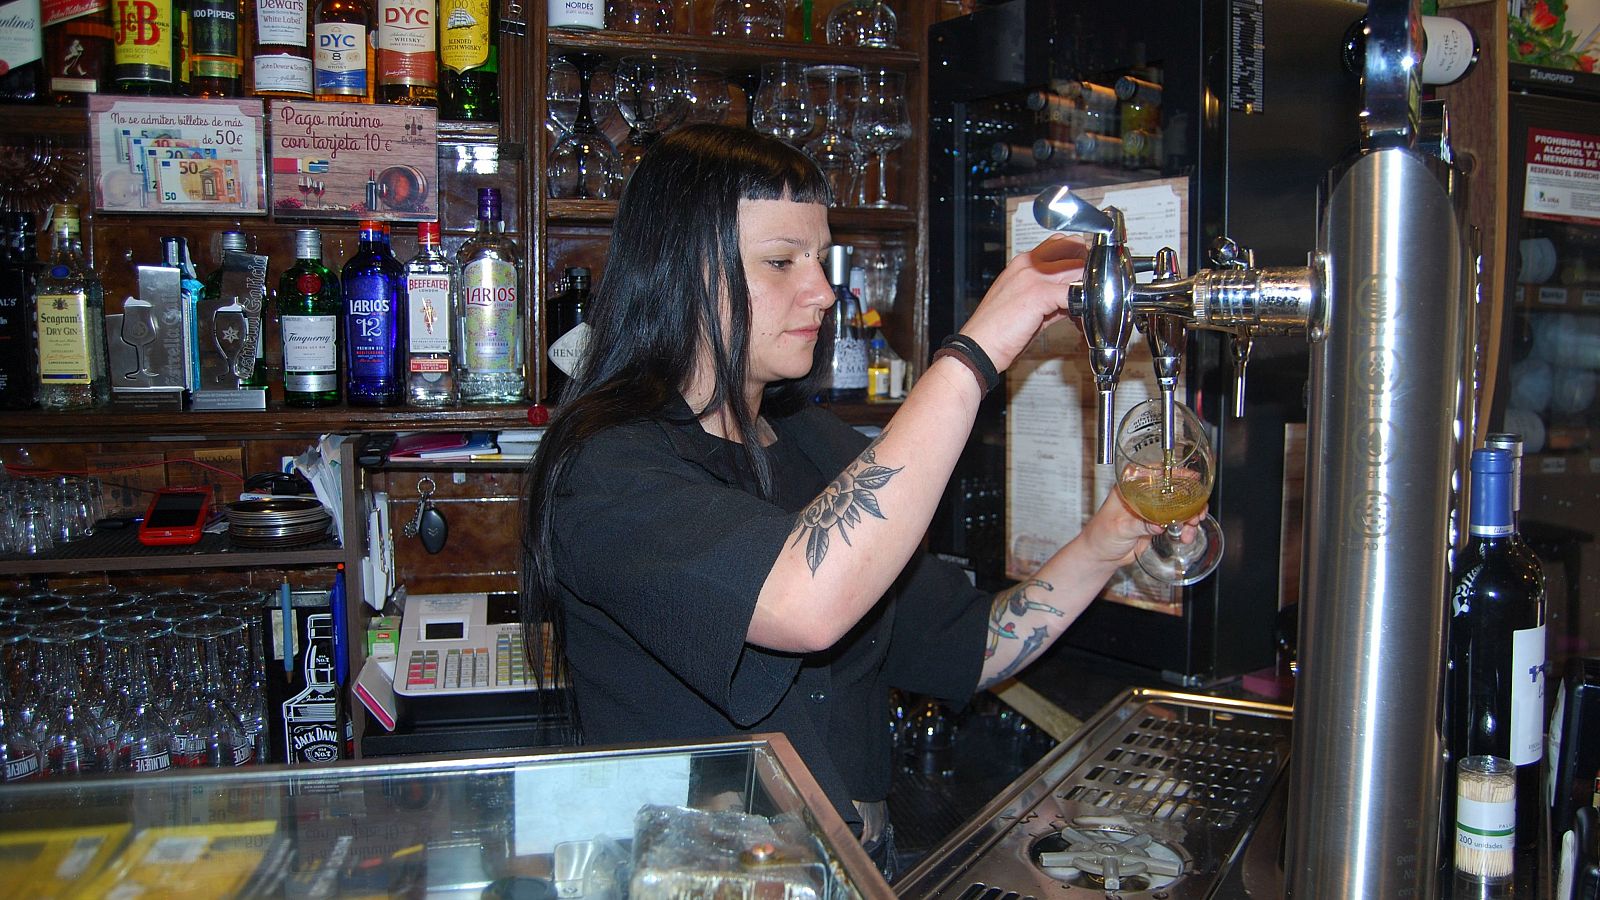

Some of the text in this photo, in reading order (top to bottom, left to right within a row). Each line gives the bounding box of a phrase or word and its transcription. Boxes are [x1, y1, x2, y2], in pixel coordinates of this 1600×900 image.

[193, 9, 235, 20] 100 PIPERS
[385, 7, 429, 25] DYC
[115, 1, 161, 46] J&B
[320, 34, 355, 47] DYC
[111, 112, 243, 127] No se admiten billetes de más
[281, 106, 383, 134] Pago mínimo
[202, 134, 213, 145] de
[281, 132, 392, 159] con tarjeta 10 €
[1535, 134, 1595, 150] PROHIBIDA LA
[1543, 145, 1584, 159] ALCOHOL
[1586, 150, 1592, 159] Y
[1534, 153, 1597, 168] A MENORES DE
[179, 161, 198, 175] 50
[165, 192, 176, 201] 50
[409, 279, 449, 291] BEEFEATER
[466, 287, 516, 306] LARIOS
[349, 299, 389, 315] LARIOS
[40, 313, 84, 326] Seagram'
[46, 327, 78, 336] DRY GIN
[356, 318, 382, 337] 12
[288, 332, 331, 344] Tanqueray
[295, 731, 316, 750] JACK
[314, 751, 332, 759] No.7
[1459, 833, 1473, 846] 200
